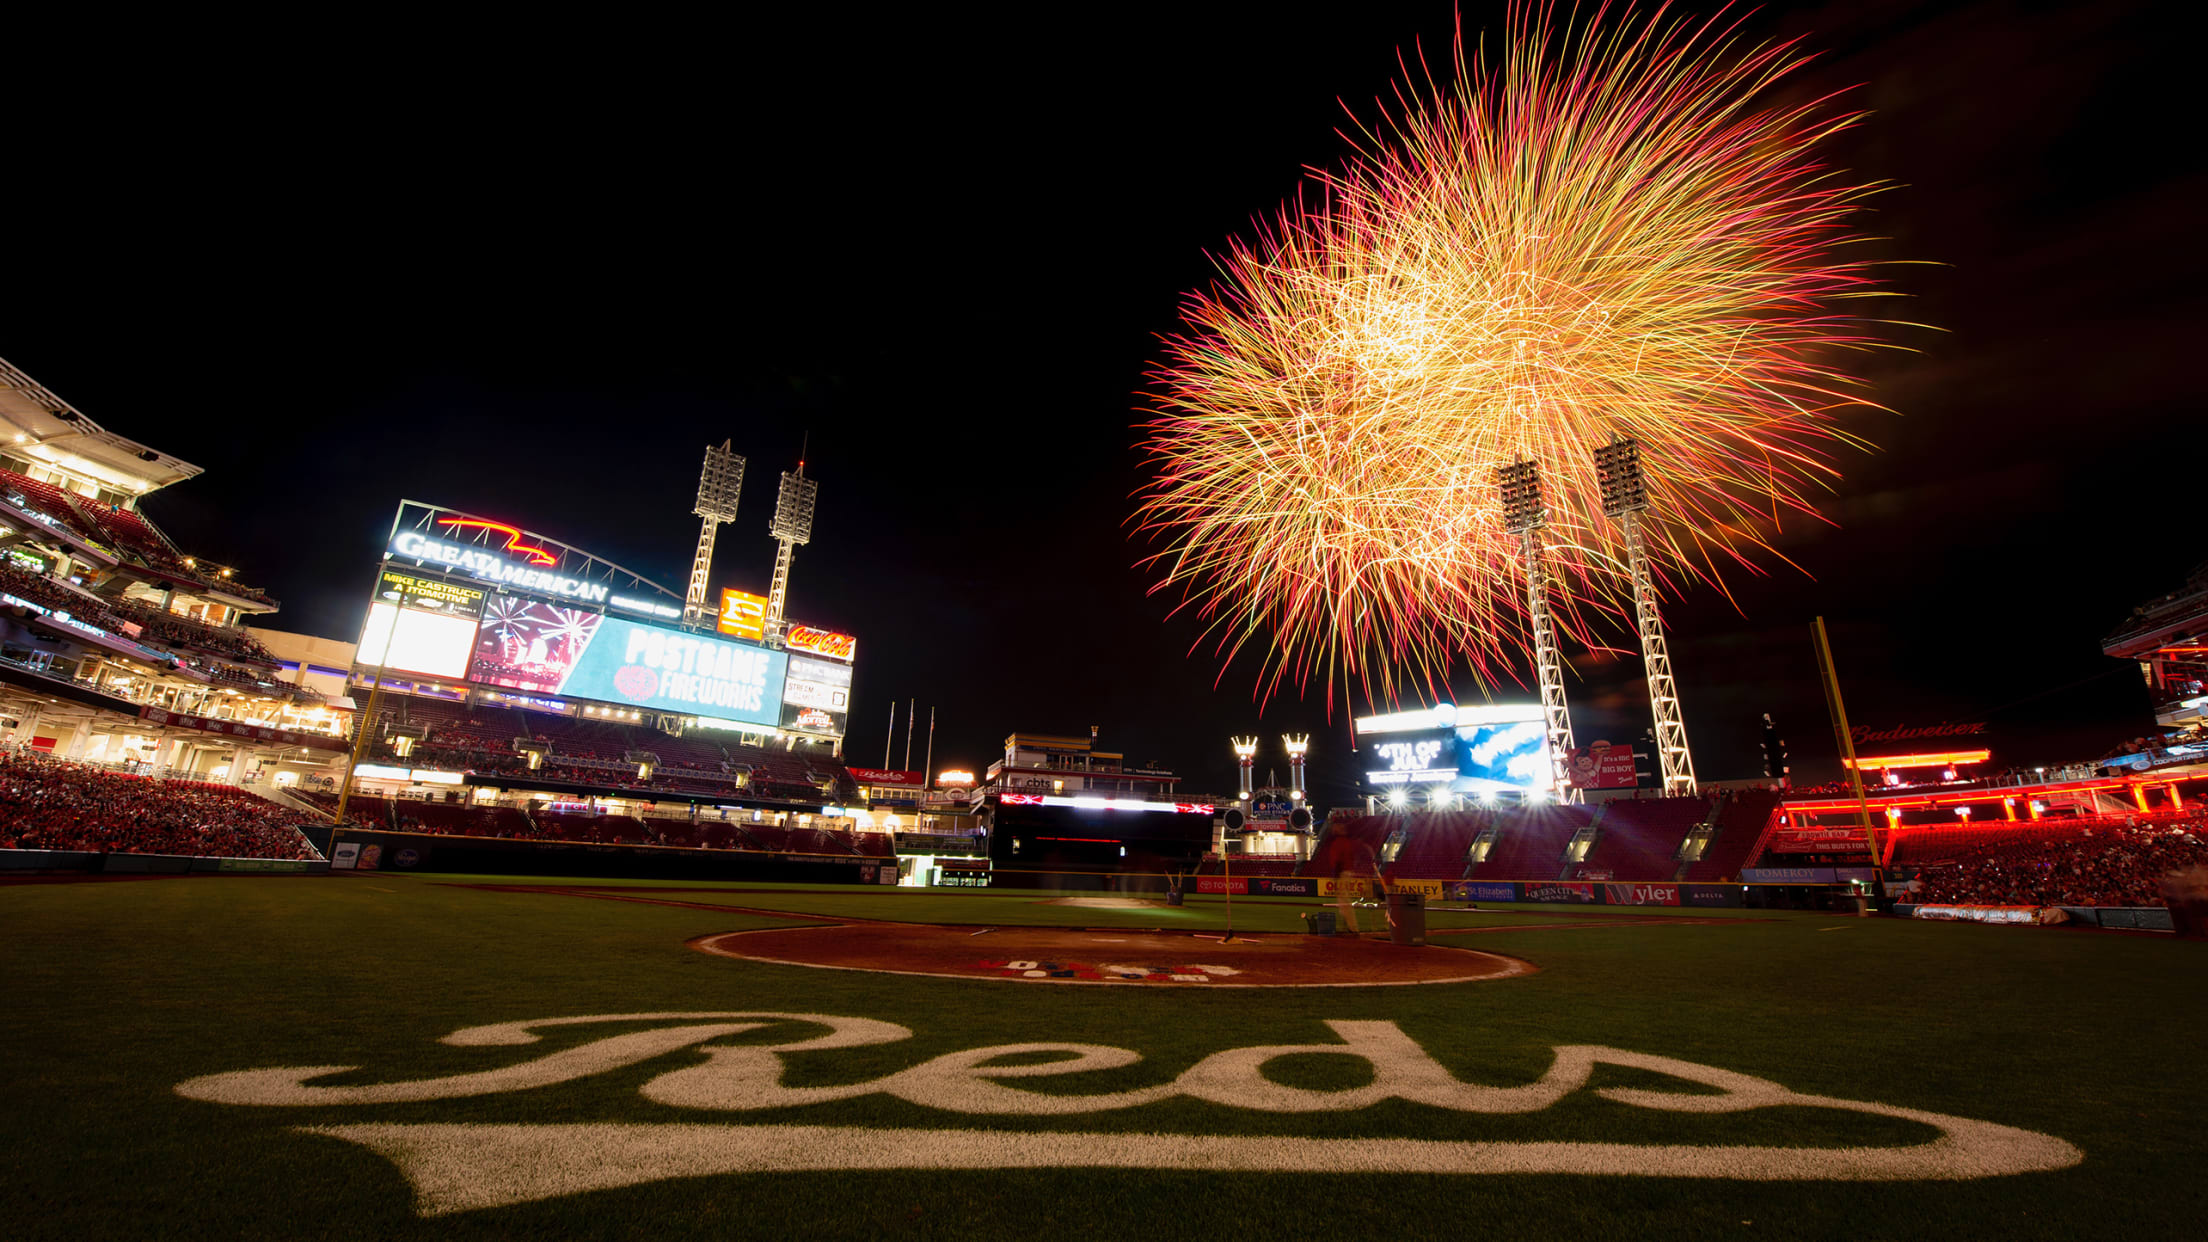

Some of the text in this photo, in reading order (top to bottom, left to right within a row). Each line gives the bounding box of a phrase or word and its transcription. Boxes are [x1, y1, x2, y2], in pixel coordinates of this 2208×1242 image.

[383, 573, 415, 586] MIKE
[417, 580, 483, 600] CASTRUCCI
[624, 628, 771, 686] POSTGAME
[658, 670, 764, 712] FIREWORKS
[1850, 721, 1988, 744] Budweiser
[1415, 740, 1441, 758] OF
[1027, 778, 1050, 788] cbts
[1266, 802, 1286, 810] PNC
[1755, 868, 1815, 879] POMEROY
[1213, 881, 1245, 889] TOYOTA
[1271, 882, 1306, 893] Fanatics
[1393, 884, 1438, 896] TANLEY
[1479, 886, 1513, 896] Elizabeth
[1530, 887, 1555, 899] QUEEN
[1606, 884, 1676, 905] Wyler
[173, 1009, 2082, 1215] Reds
